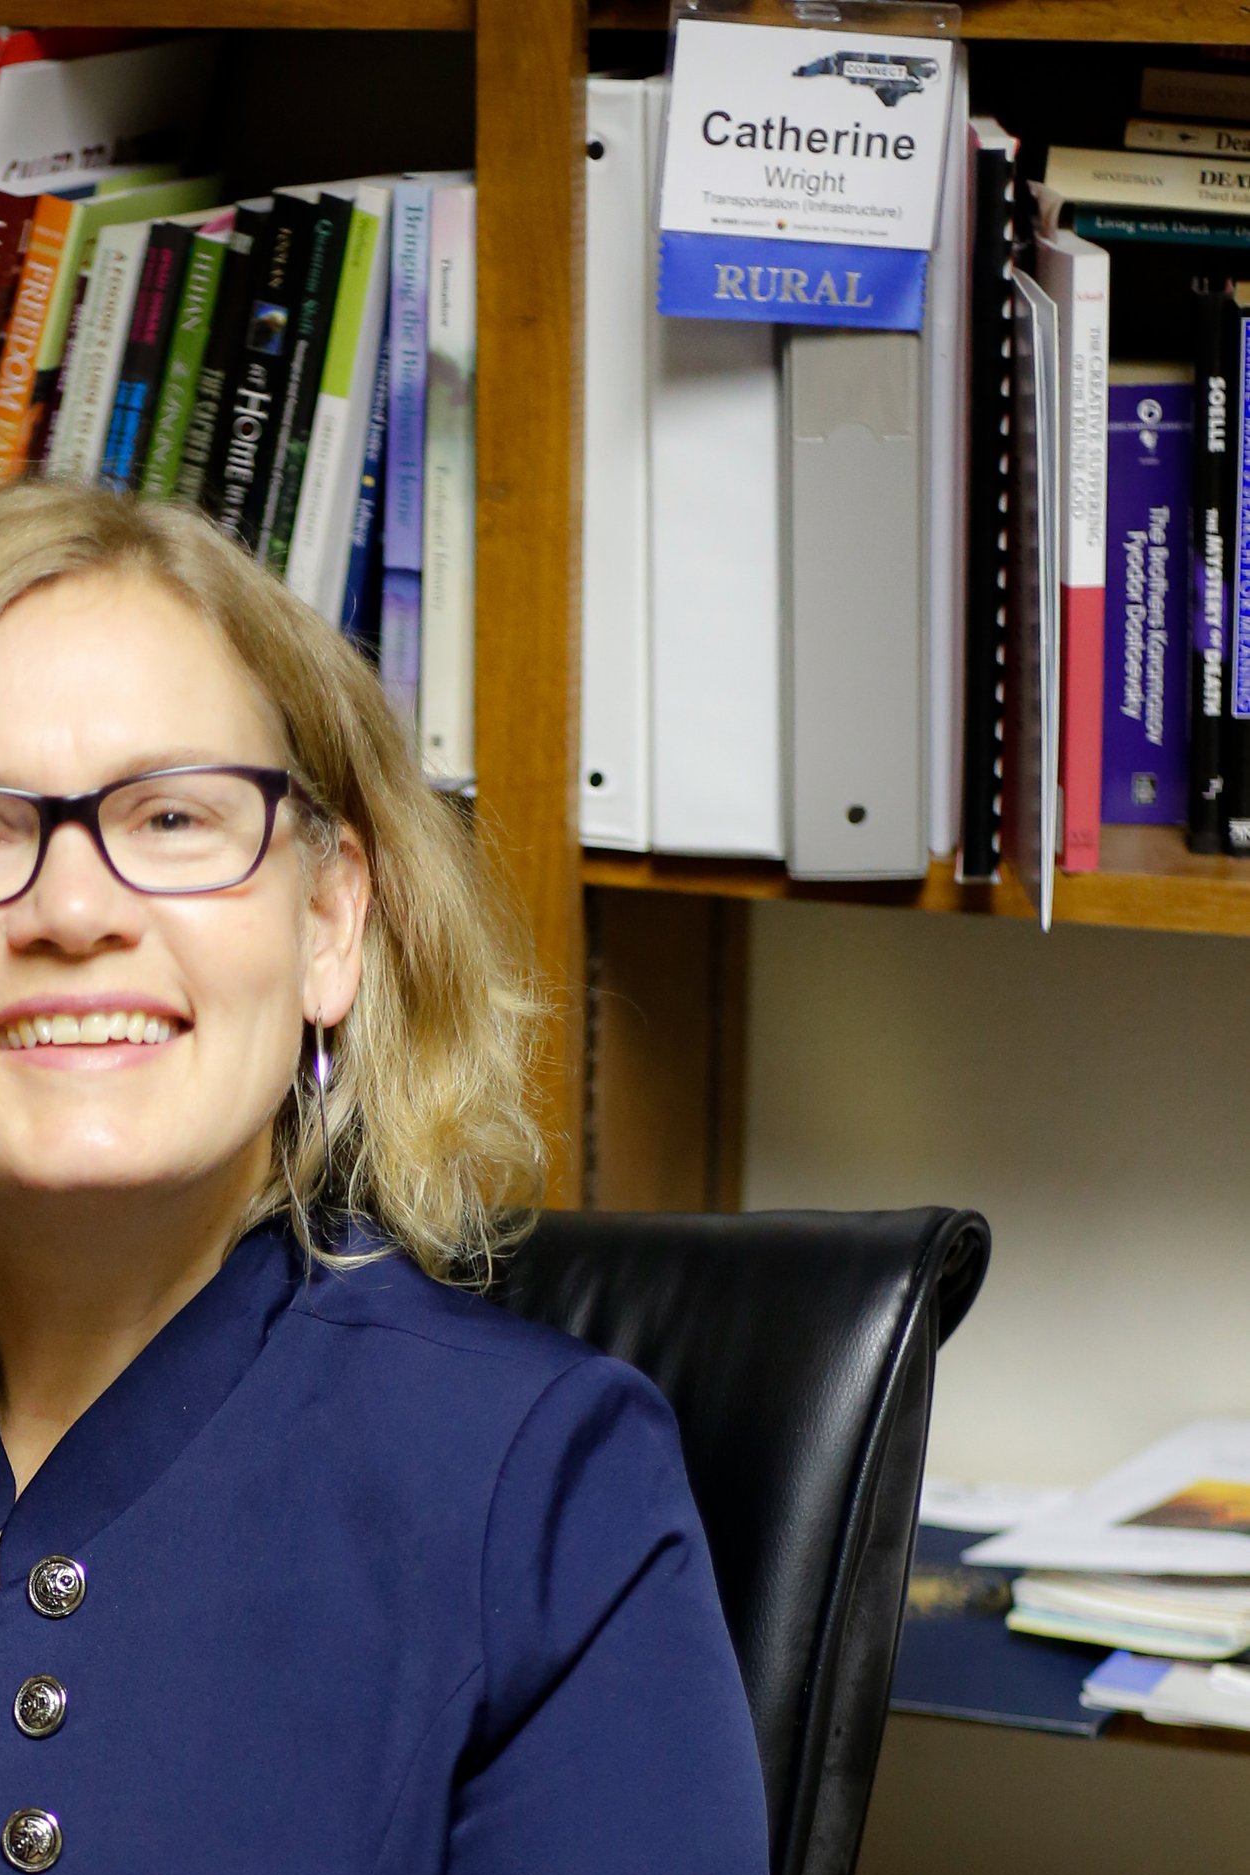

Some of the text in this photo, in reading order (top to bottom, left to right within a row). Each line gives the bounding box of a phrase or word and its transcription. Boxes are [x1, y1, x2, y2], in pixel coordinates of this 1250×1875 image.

[846, 63, 905, 78] CONNECT
[703, 111, 916, 161] Catherine
[702, 190, 902, 220] Transportation (Infrastructure)
[765, 165, 846, 196] Wright
[713, 264, 874, 308] RURAL
[391, 205, 425, 529] Bringing the Biosphere Home
[1086, 354, 1105, 443] CREATIVE
[1071, 404, 1086, 469] TRIUNE
[1206, 375, 1226, 452] SOELLE
[1070, 476, 1086, 521] GOD
[1085, 448, 1104, 547] SUFFERING
[1204, 533, 1223, 626] MYSTERY
[1118, 529, 1149, 720] Fyodor Dostoevsky
[1141, 504, 1171, 746] The Brothers Karamazov
[1202, 648, 1221, 716] DEATH
